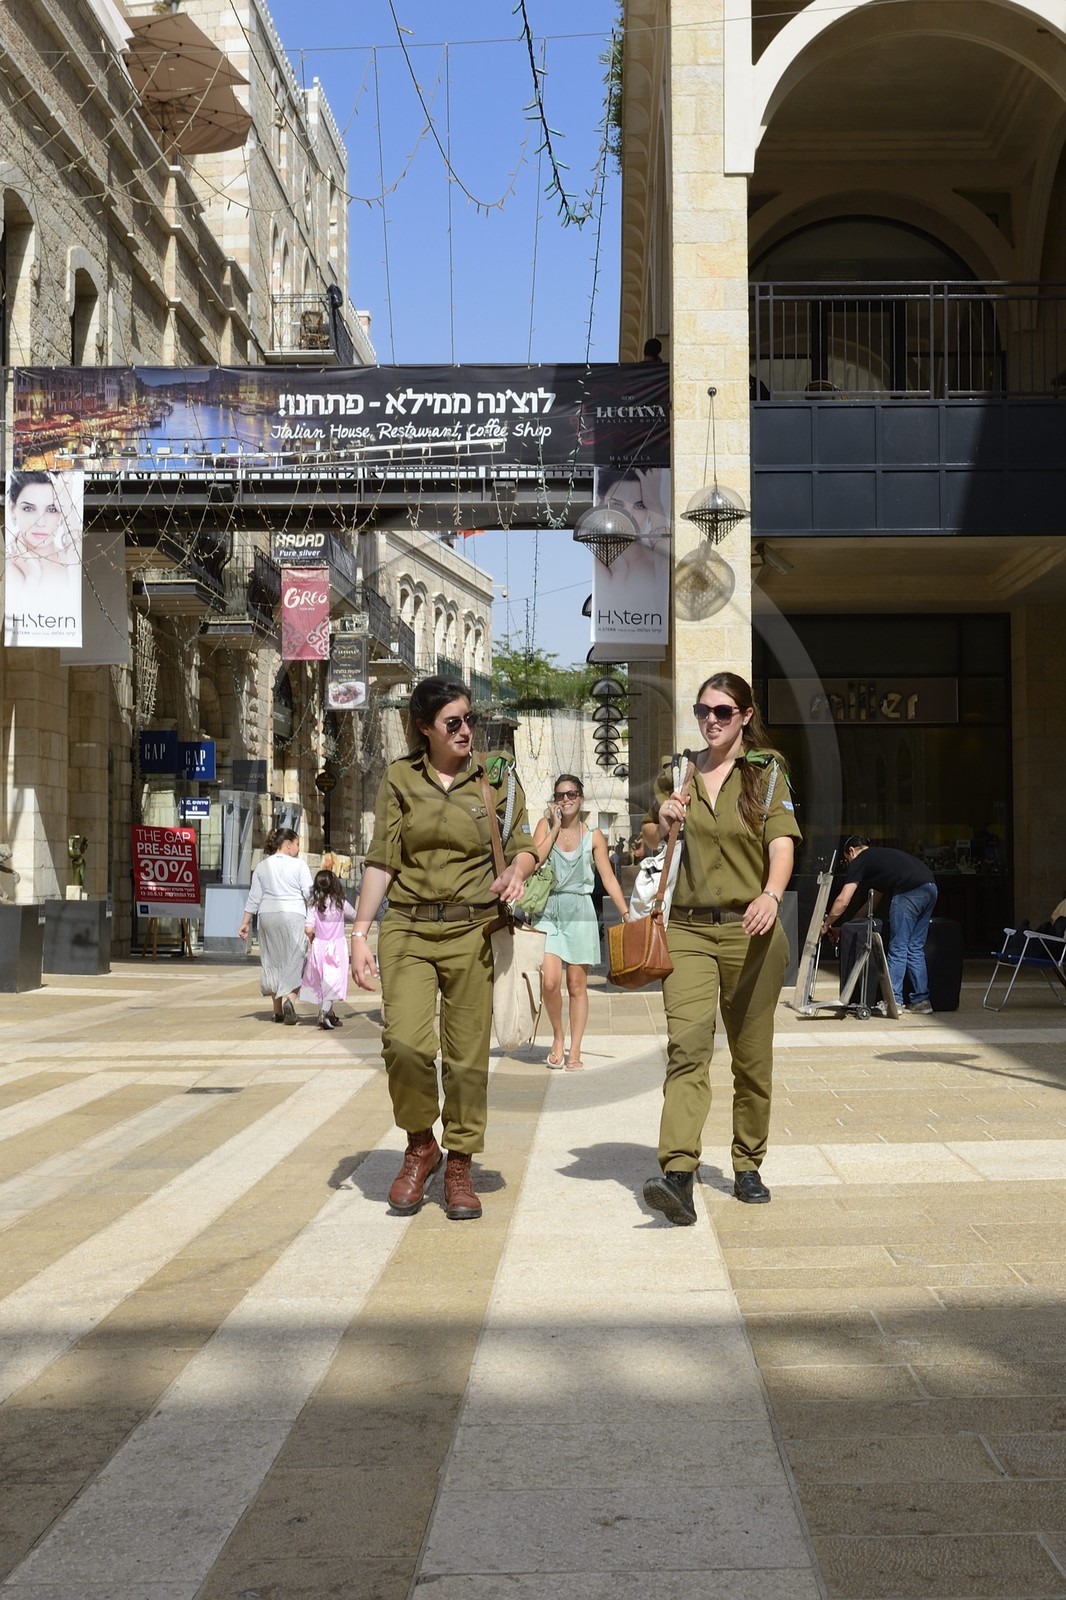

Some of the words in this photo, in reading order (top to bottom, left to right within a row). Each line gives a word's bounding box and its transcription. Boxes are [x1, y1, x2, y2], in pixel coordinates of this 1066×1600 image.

[278, 393, 364, 417] פתחנו!
[385, 388, 471, 415] ממילא
[596, 405, 666, 418] LUCIANA
[271, 422, 325, 439] Italian
[330, 424, 374, 439] House,
[376, 420, 462, 441] Restaurant,
[467, 418, 509, 440] Coffee
[512, 421, 552, 445] Shop
[275, 533, 325, 548] HADAD
[12, 613, 76, 628] H.Stern
[598, 610, 662, 625] H.Stern
[144, 743, 166, 760] GAP
[185, 749, 206, 766] GAP
[136, 829, 162, 842] THE
[164, 831, 191, 843] GAP
[137, 842, 193, 857] PRE-SALE
[140, 859, 193, 882] 30%
